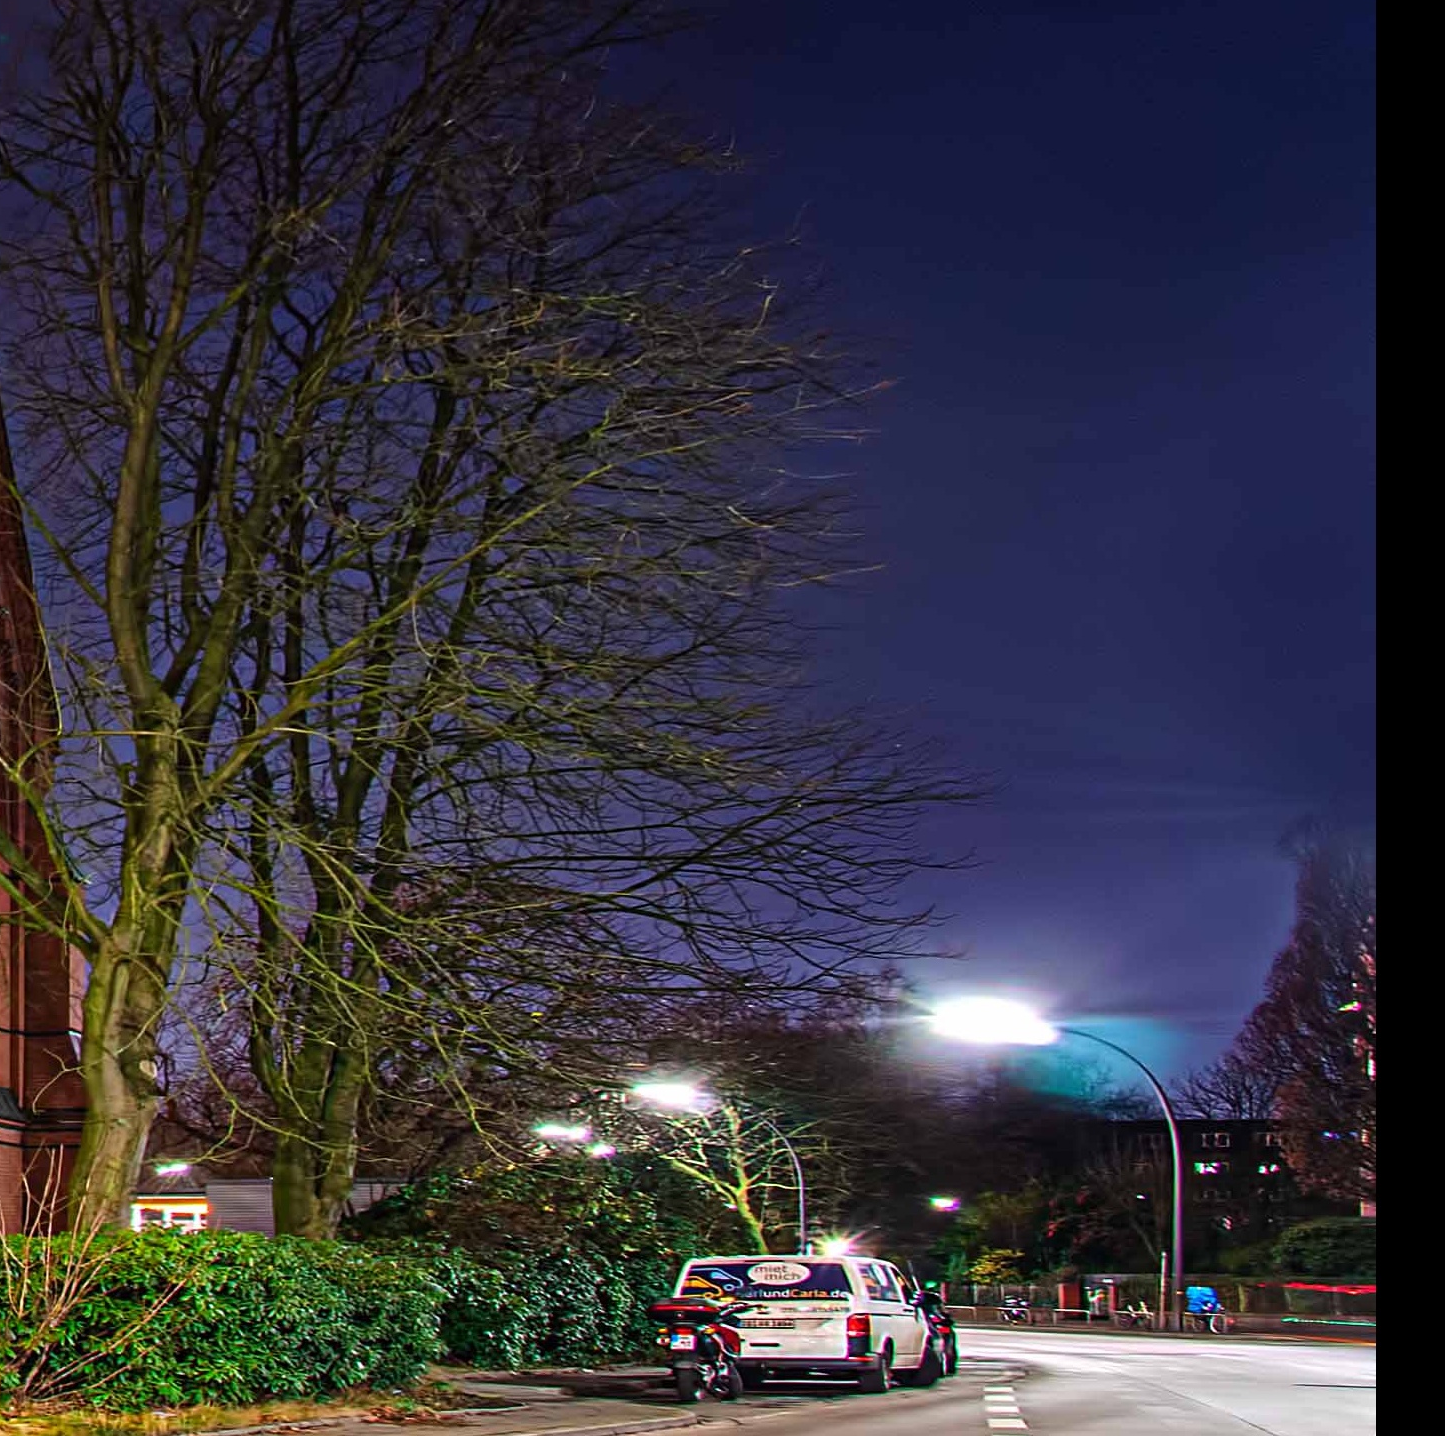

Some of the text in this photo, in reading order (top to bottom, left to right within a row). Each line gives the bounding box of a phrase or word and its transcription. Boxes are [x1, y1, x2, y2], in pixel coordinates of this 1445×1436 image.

[754, 1265, 788, 1273] miet
[764, 1272, 801, 1281] mich
[736, 1288, 849, 1298] arlundCarla.de
